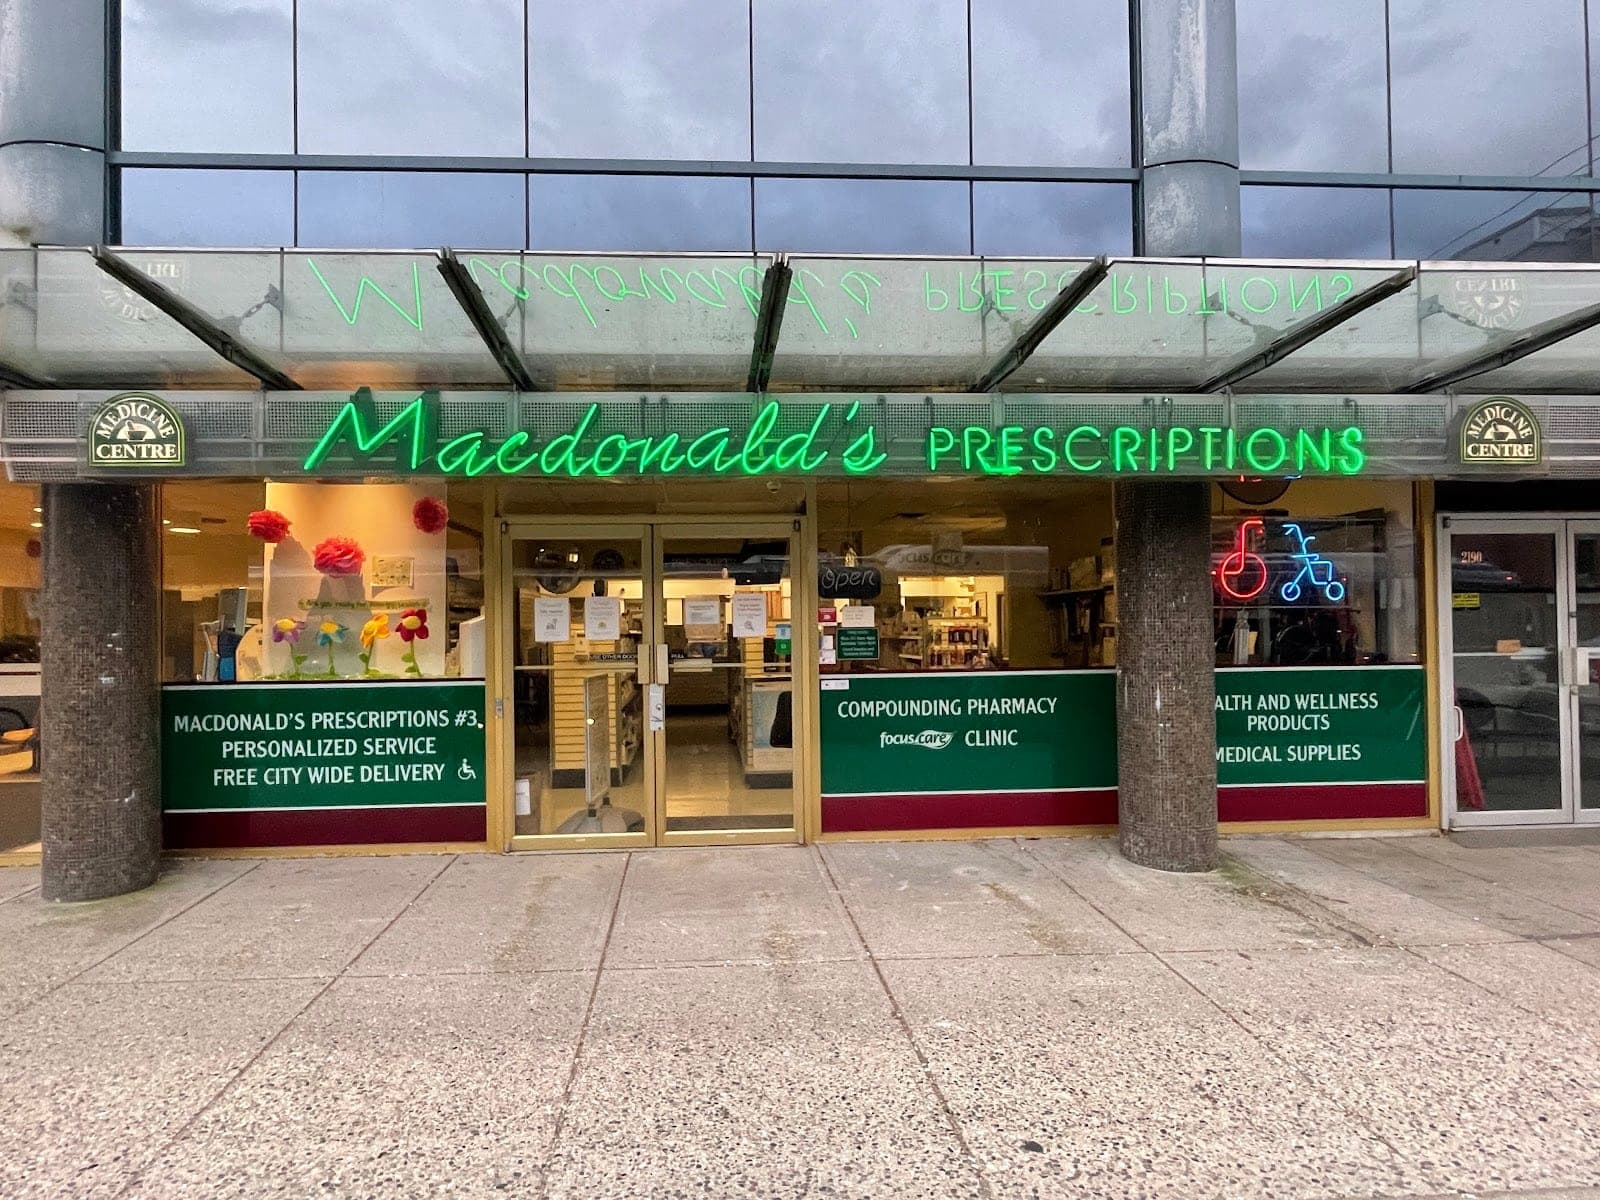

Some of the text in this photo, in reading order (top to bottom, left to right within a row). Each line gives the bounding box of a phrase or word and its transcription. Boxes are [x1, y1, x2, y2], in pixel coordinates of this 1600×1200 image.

[96, 402, 175, 439] MEDICINE
[1467, 405, 1533, 439] MEDICINE
[303, 397, 1366, 477] Macdonald's PRESCRIPTIONS
[96, 443, 177, 459] CENTRE
[1467, 443, 1534, 457] CENTRE
[837, 697, 1058, 718] COMPOUNDING PHARMACY
[1214, 693, 1379, 711] ALTH AND WELLNESS
[174, 712, 306, 732] MACDONALD'S
[311, 709, 449, 730] PRESCRIPTIONS
[1247, 714, 1330, 731] PRODUCTS
[222, 737, 437, 759] PERSONALIZED SERVICE
[964, 729, 1018, 747] CLINIC
[1215, 744, 1362, 763] MEDICAL SUPPLIES
[213, 763, 445, 786] FREE CITY WIDE DELIVERY
